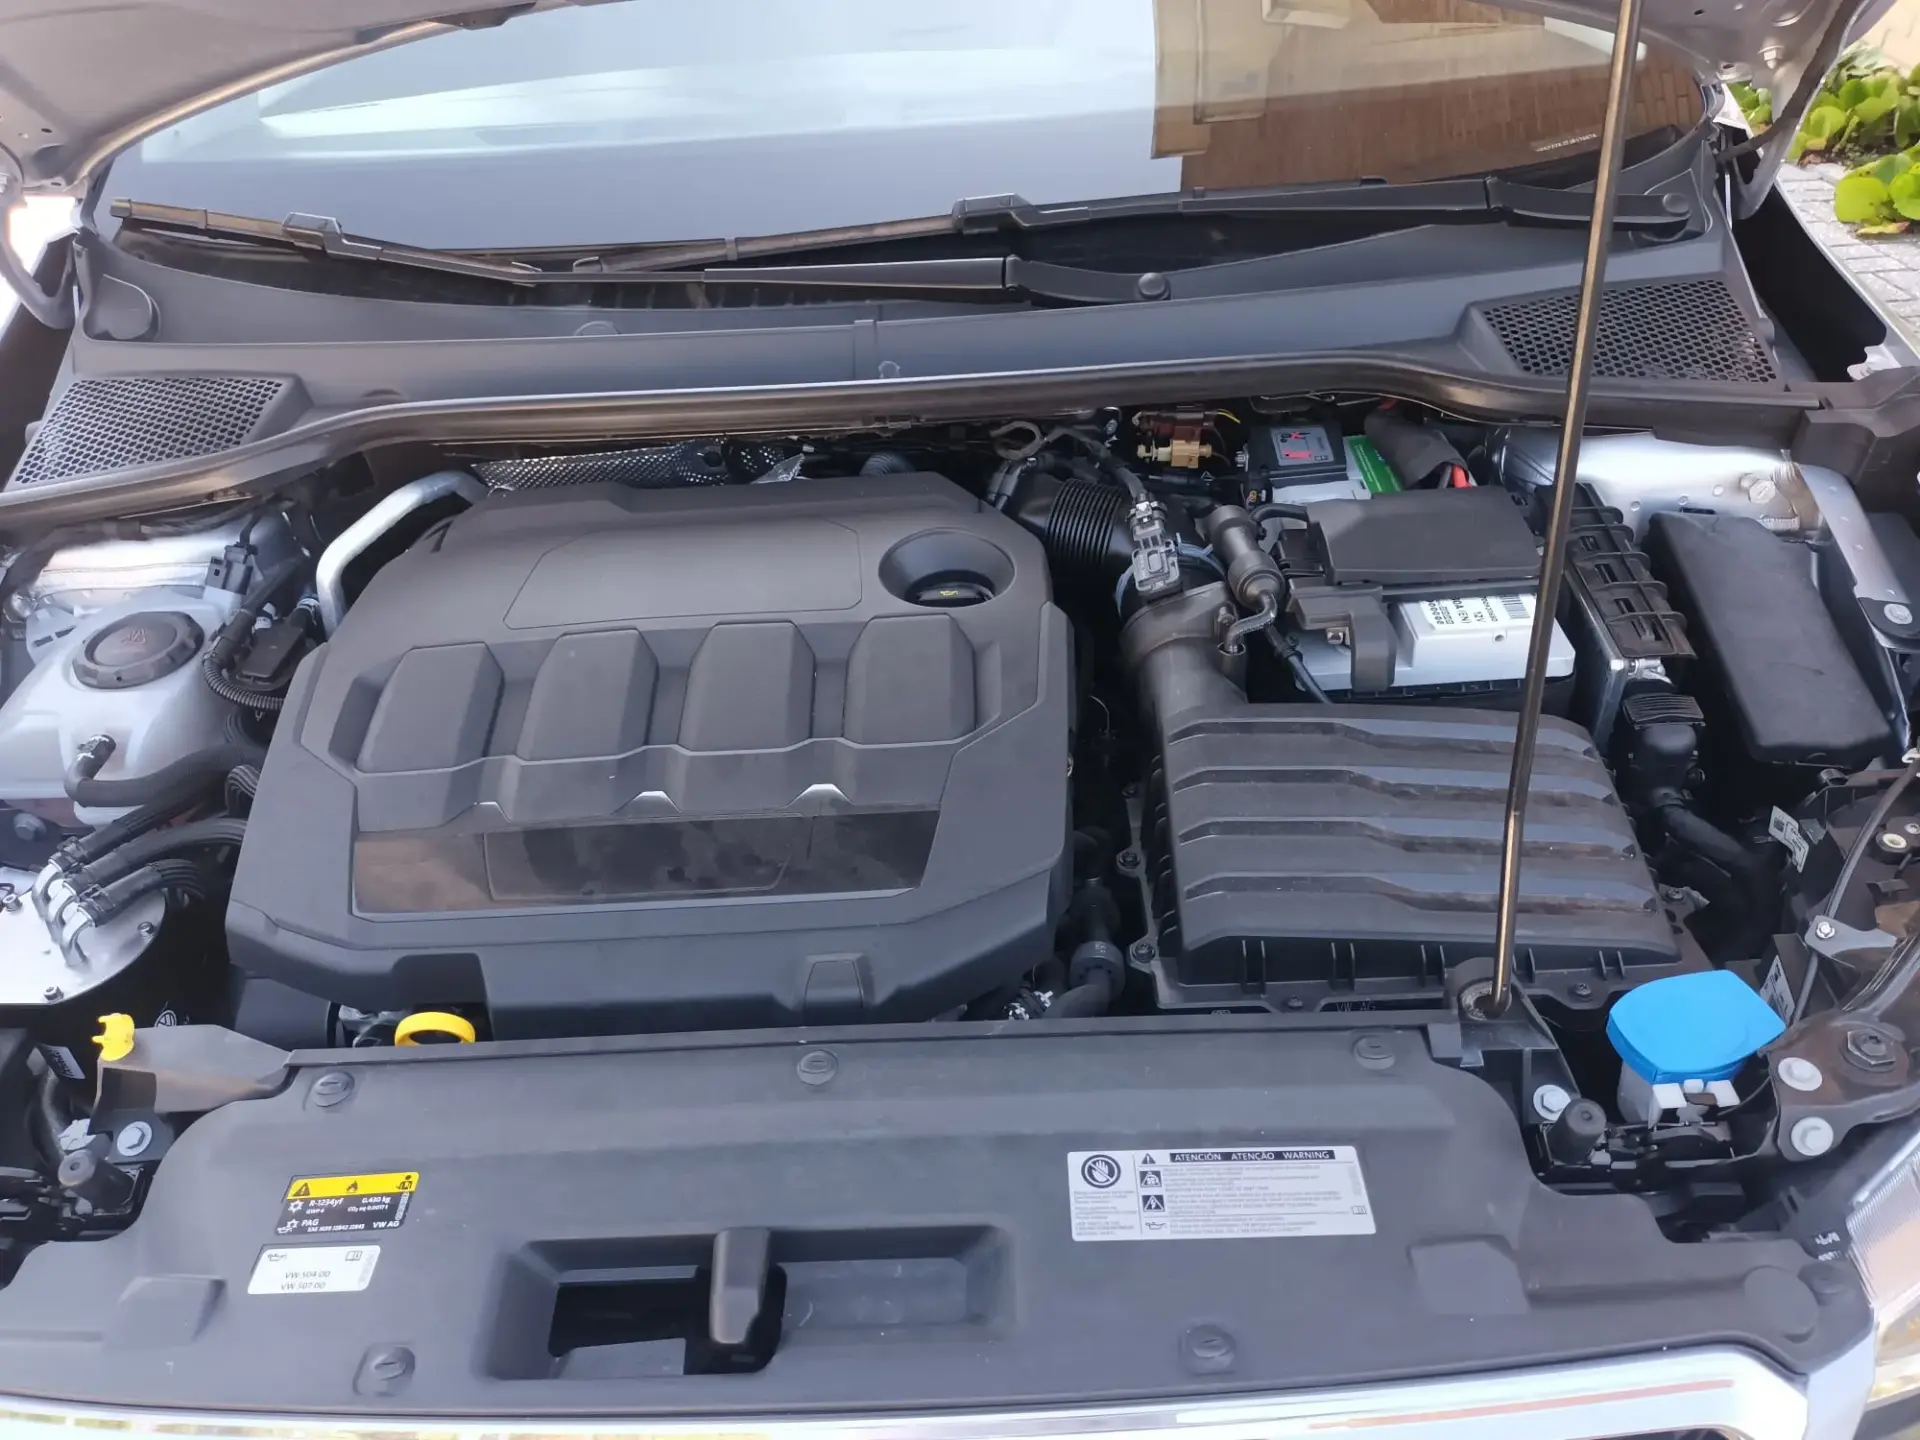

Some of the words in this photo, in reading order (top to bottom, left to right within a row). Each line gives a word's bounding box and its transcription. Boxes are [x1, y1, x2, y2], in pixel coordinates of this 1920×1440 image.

[1335, 1001, 1353, 1013] VW
[1174, 1151, 1222, 1162] ATENCIÓN
[1231, 1150, 1275, 1161] ATENÇÃO
[1282, 1150, 1330, 1160] WARNING
[308, 1197, 345, 1208] R-1234yf
[382, 1195, 392, 1204] kg
[301, 1218, 320, 1227] PAG
[372, 1221, 387, 1229] VW
[387, 1220, 400, 1228] AG
[285, 1270, 300, 1279] VW
[281, 1282, 296, 1290] VW
